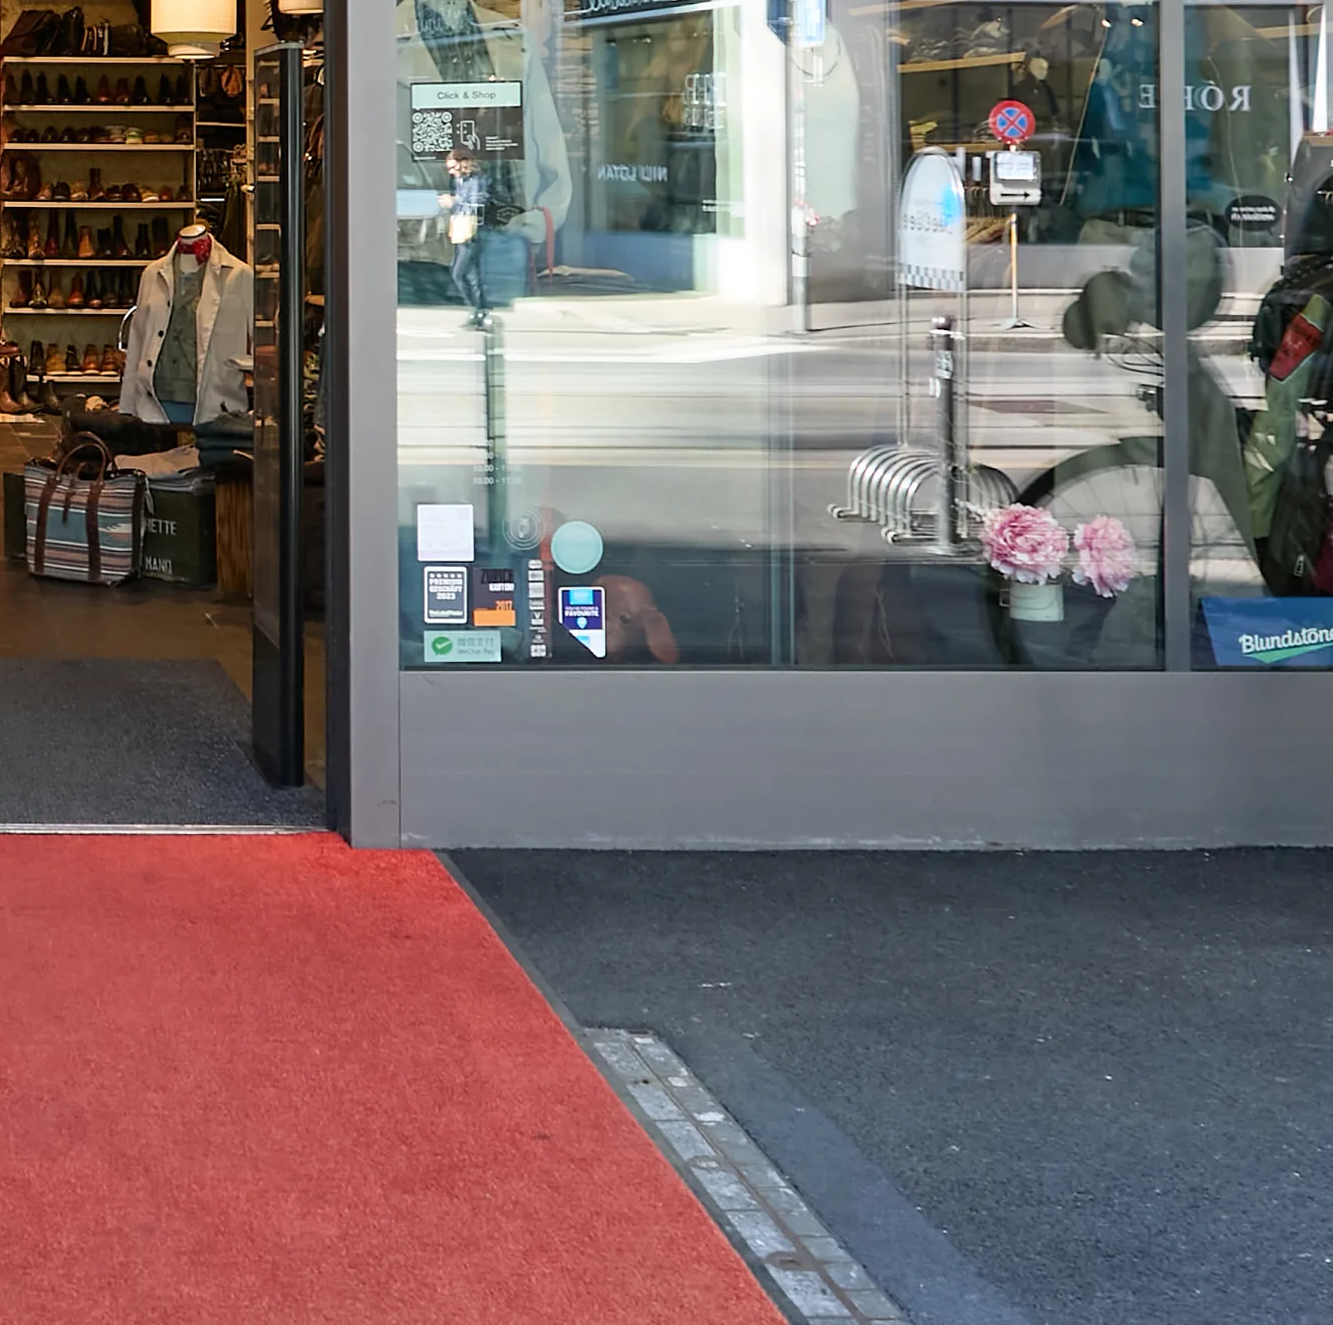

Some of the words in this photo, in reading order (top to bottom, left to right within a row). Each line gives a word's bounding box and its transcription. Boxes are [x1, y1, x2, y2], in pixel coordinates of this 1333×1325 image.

[437, 90, 460, 100] Click
[463, 91, 469, 99] &
[472, 90, 496, 100] Shop
